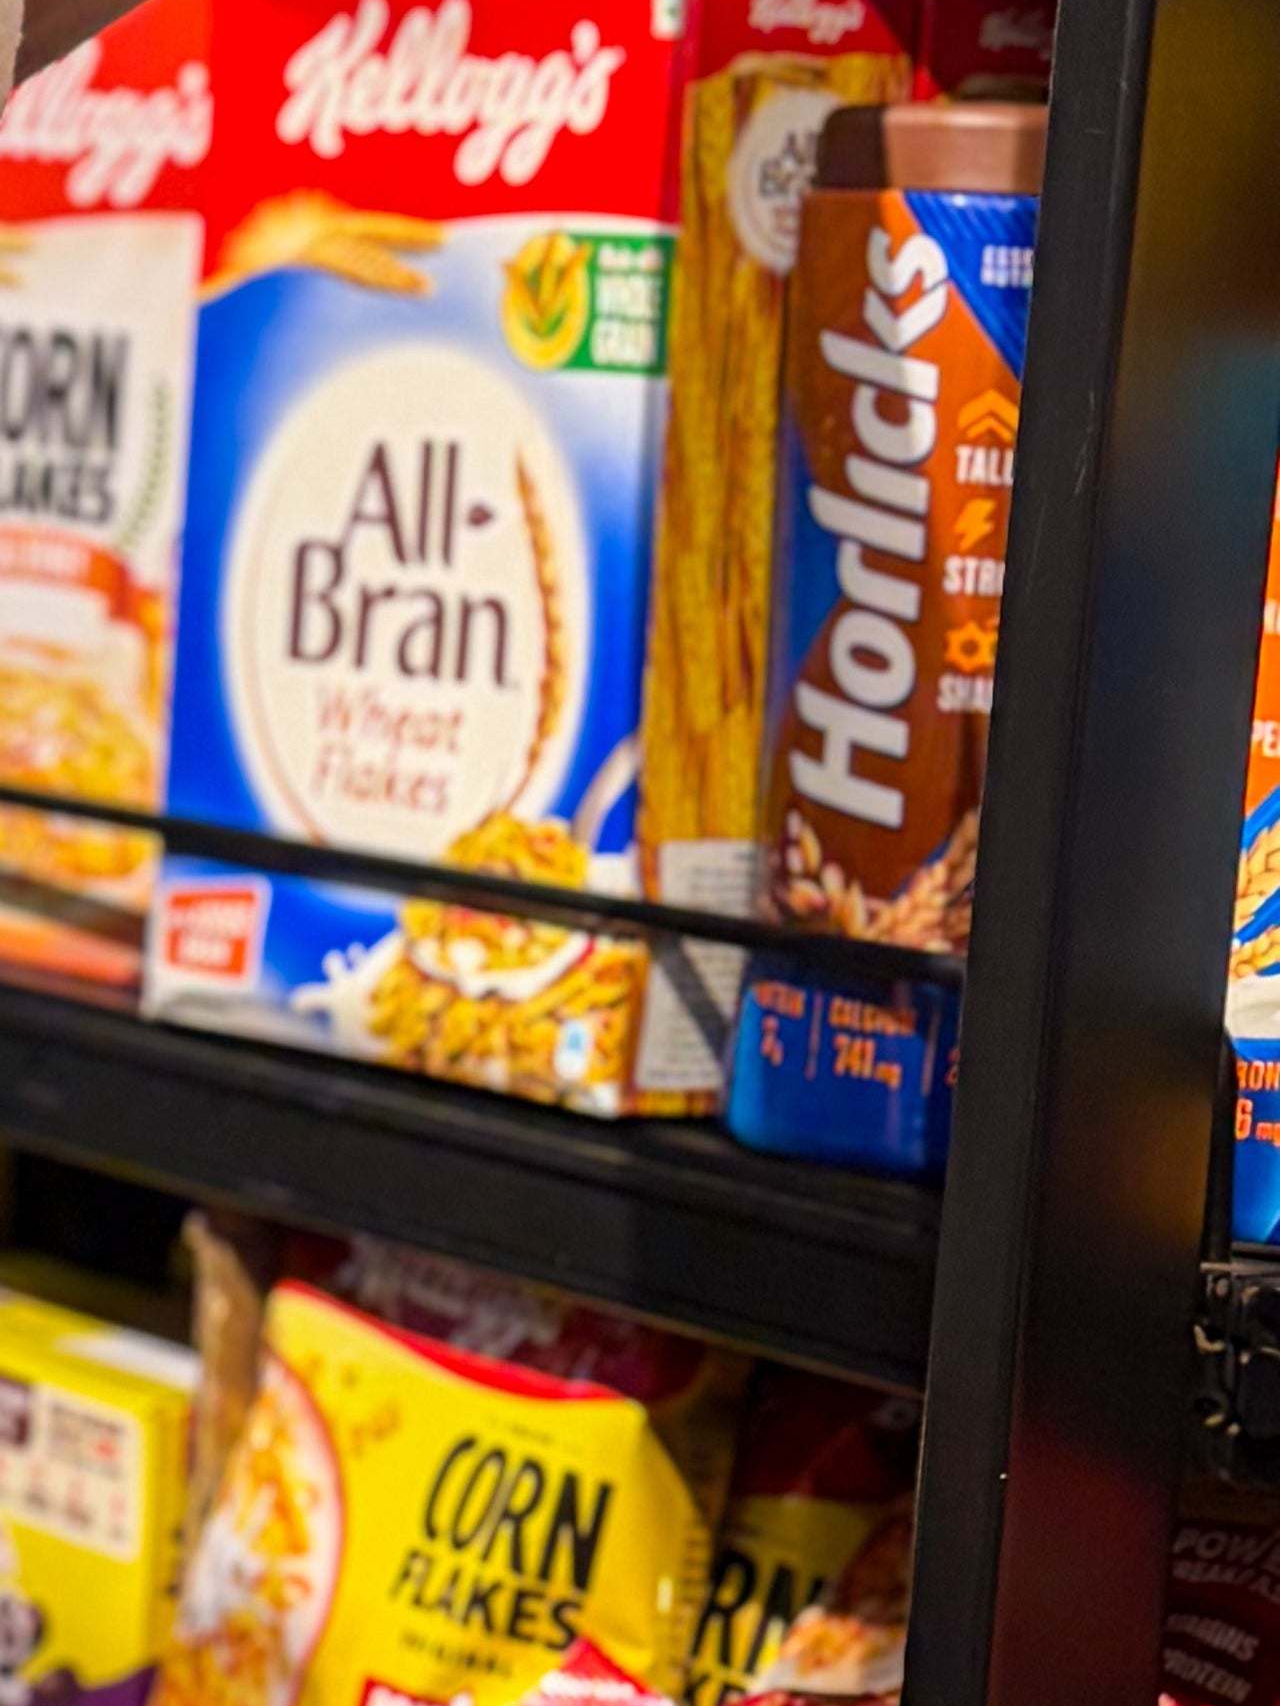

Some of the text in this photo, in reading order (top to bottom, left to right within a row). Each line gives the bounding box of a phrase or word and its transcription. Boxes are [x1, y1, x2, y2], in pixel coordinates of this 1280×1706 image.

[788, 225, 950, 831] Horlicks
[954, 444, 1015, 487] TALL
[287, 539, 513, 689] Bran
[424, 1434, 616, 1593] CORN
[390, 1548, 585, 1653] FLAKES
